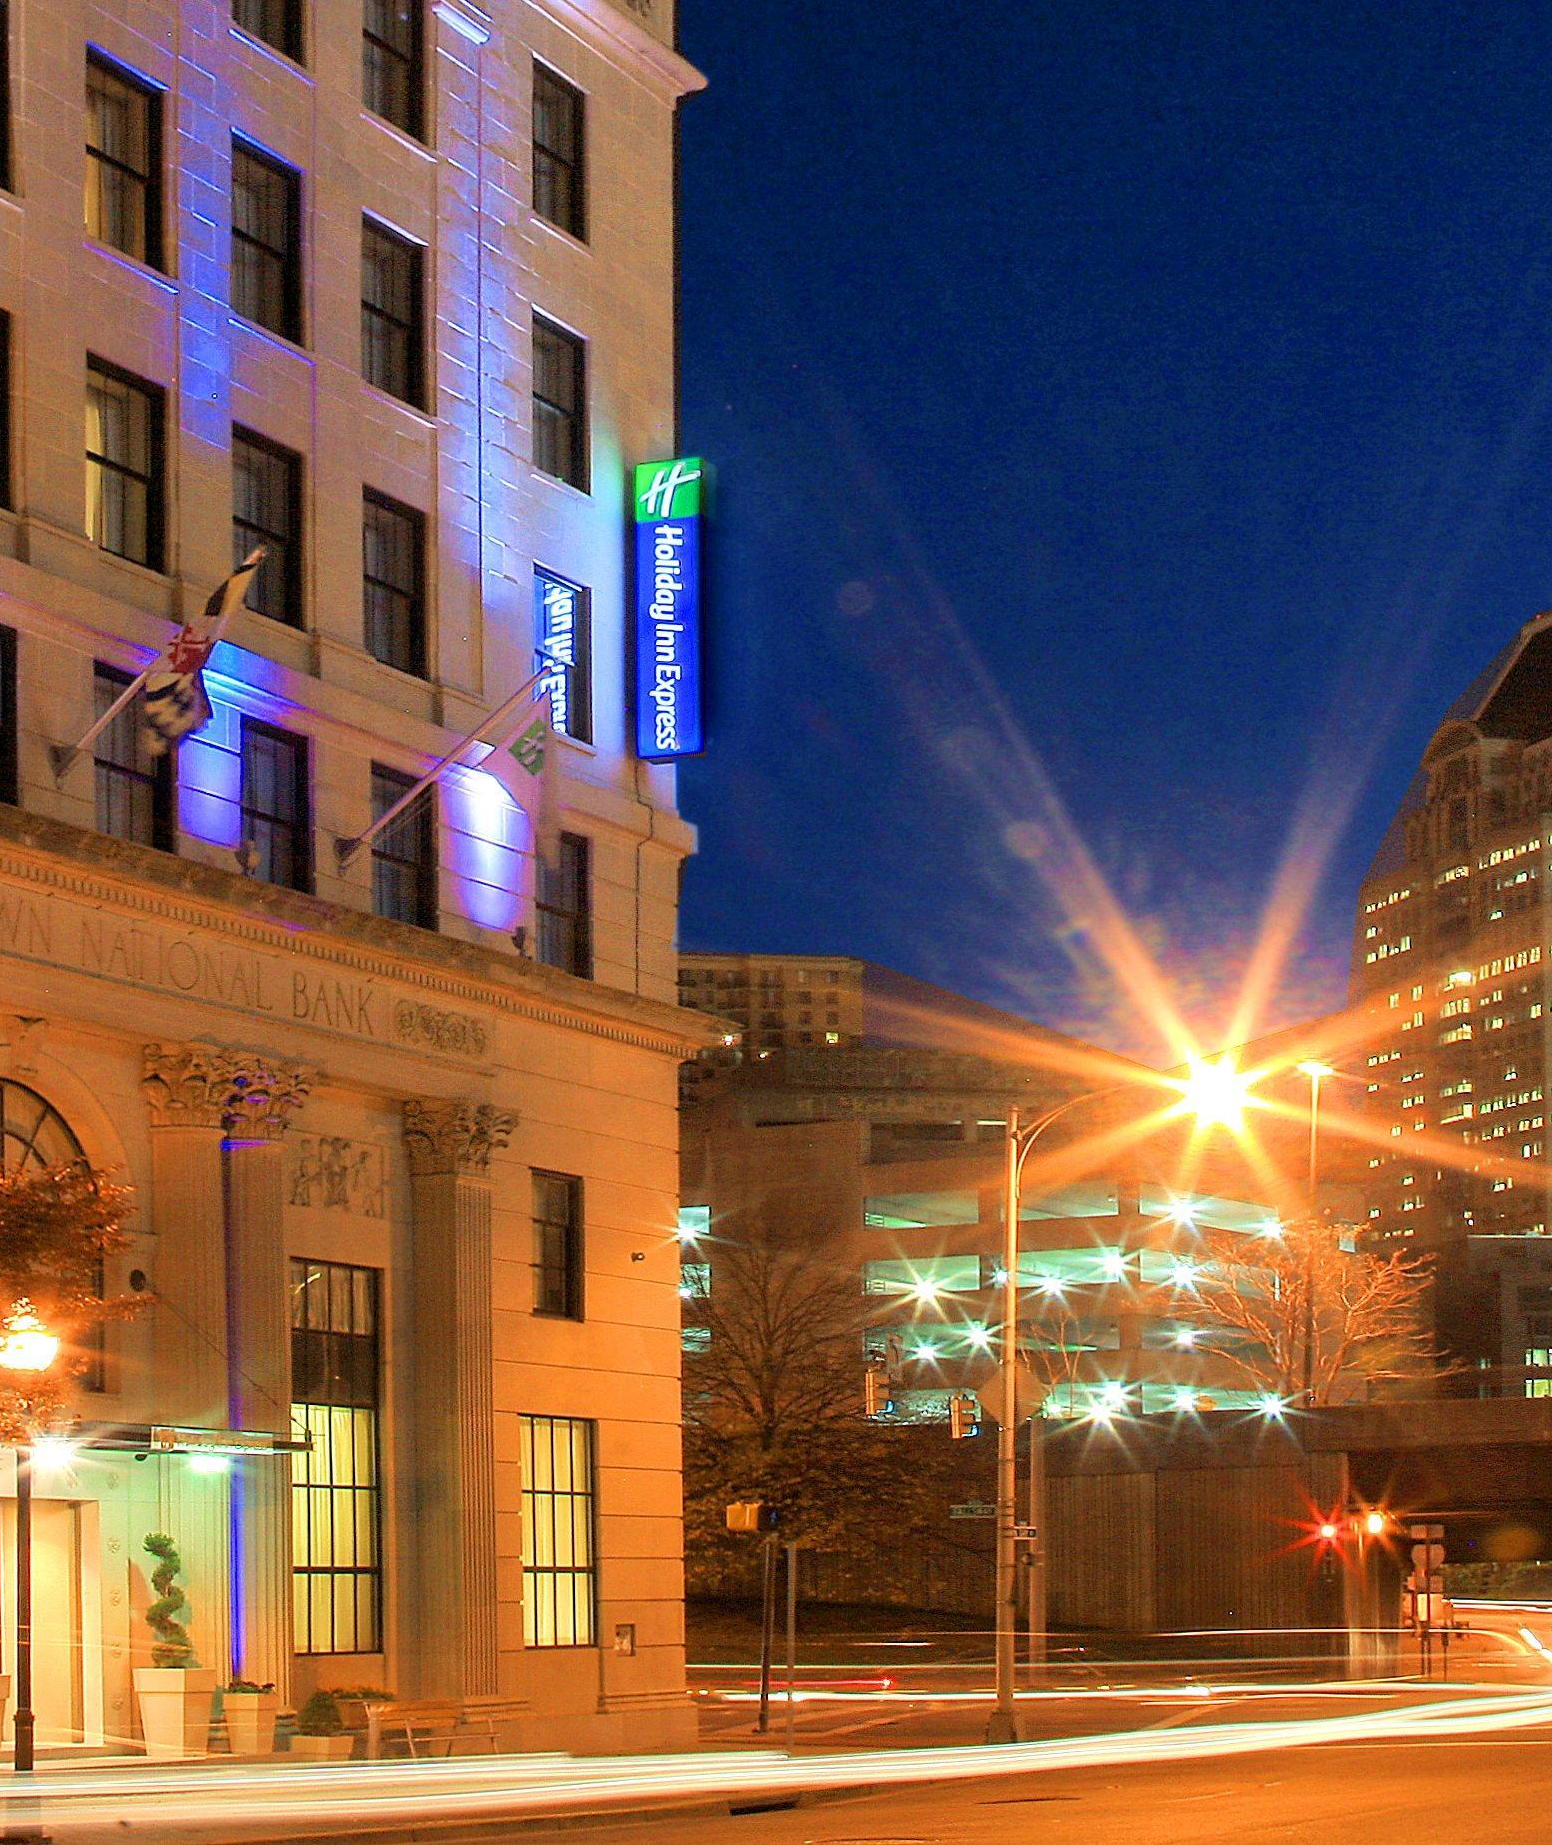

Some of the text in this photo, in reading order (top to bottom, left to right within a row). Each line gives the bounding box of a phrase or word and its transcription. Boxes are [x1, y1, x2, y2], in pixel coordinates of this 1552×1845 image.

[648, 524, 684, 751] Holiday Inn Express
[82, 920, 273, 1011] NATIONAL
[293, 972, 374, 1036] BANK
